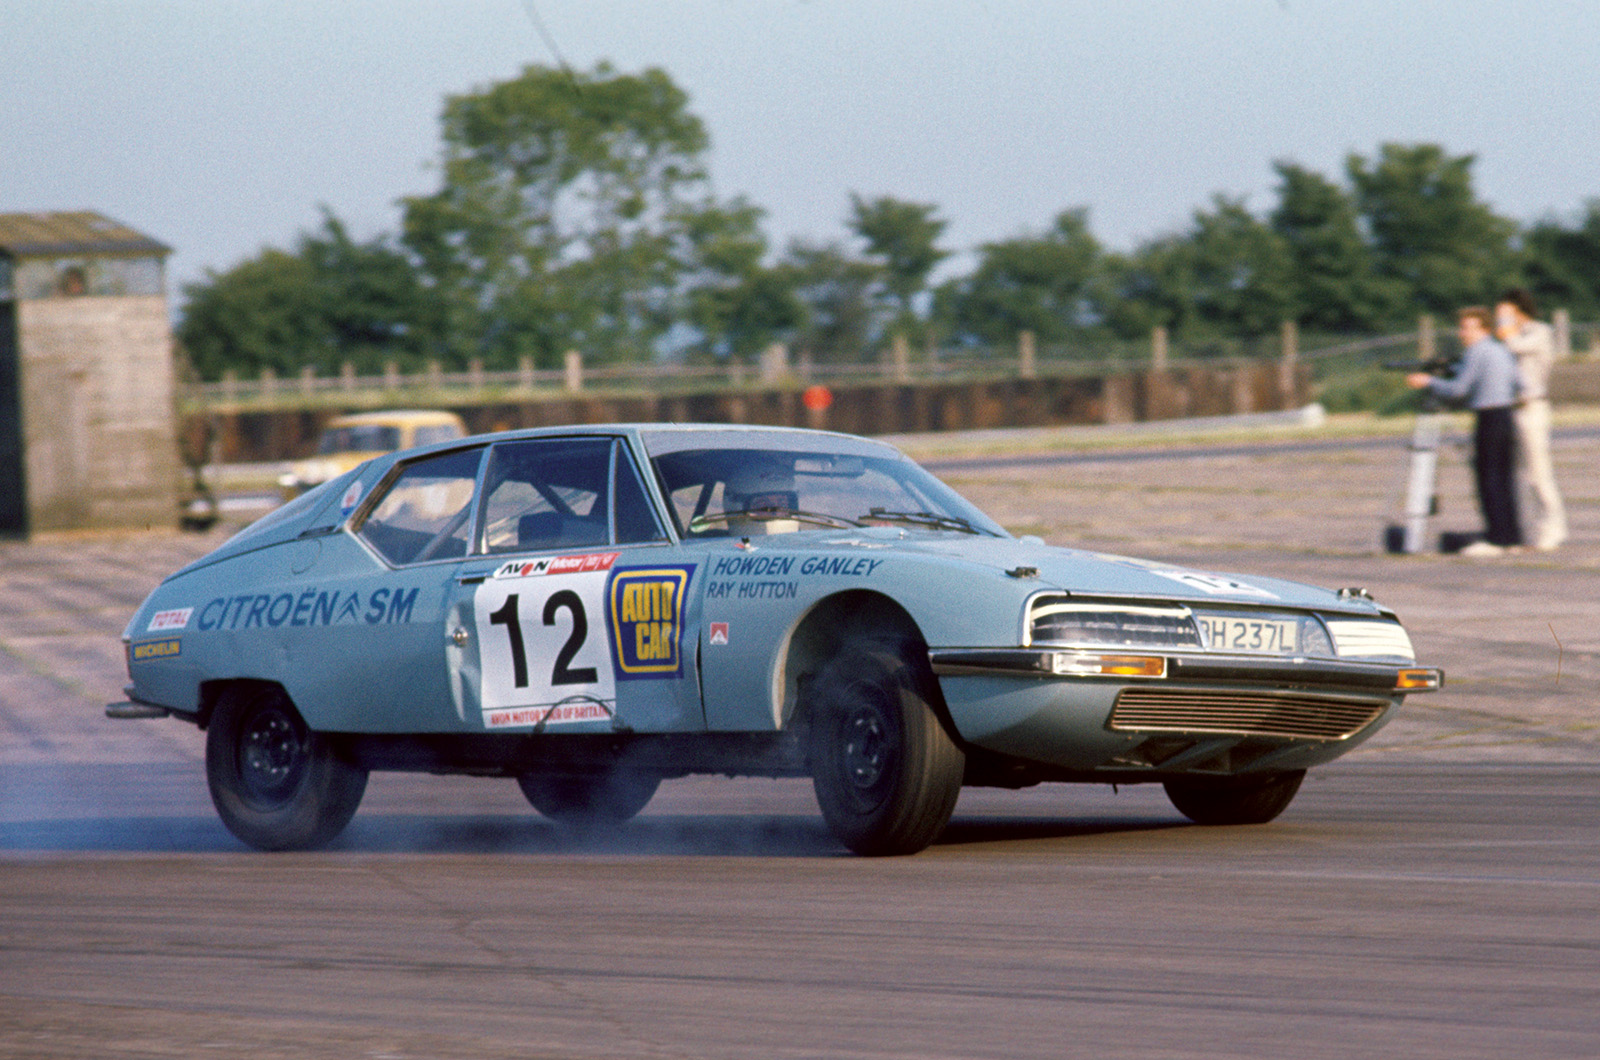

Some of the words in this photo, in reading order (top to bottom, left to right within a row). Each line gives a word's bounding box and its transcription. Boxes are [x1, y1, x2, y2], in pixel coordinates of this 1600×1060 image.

[713, 557, 796, 575] HOWDEN
[800, 557, 884, 576] GANLEY
[706, 581, 736, 598] RAY
[737, 581, 799, 598] HUTTON
[197, 587, 340, 631] CITROËN
[364, 587, 420, 624] SM
[622, 582, 676, 622] AUTO
[150, 611, 188, 628] TOTAL
[490, 589, 599, 689] 12
[635, 622, 673, 660] CAR
[1233, 622, 1294, 651] 237L
[134, 640, 180, 659] MICHELIN
[512, 709, 540, 724] MOTOR
[563, 706, 573, 719] OF
